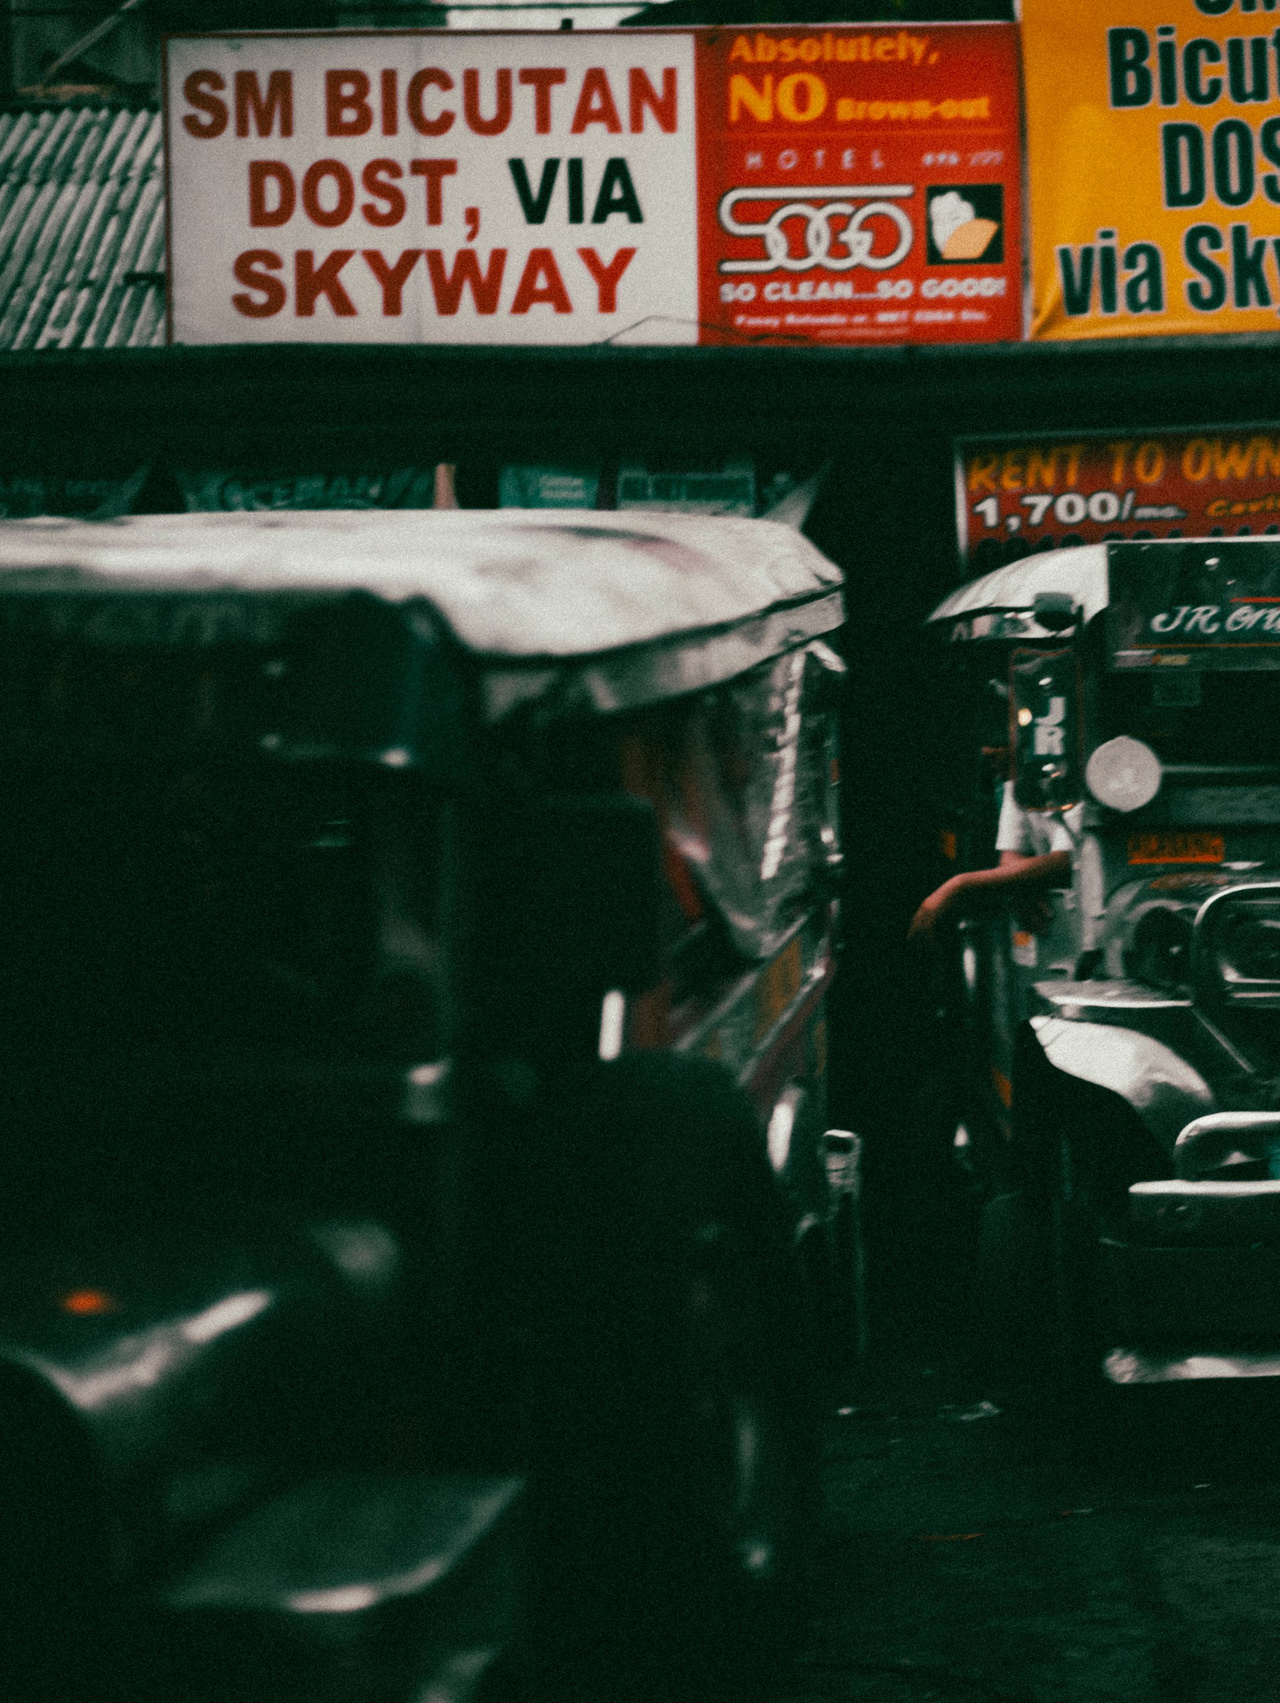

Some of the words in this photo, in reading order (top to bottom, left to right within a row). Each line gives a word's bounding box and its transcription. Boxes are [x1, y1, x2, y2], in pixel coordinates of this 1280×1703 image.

[182, 69, 294, 139] SM
[326, 67, 679, 137] BICUTAN
[730, 72, 827, 122] NO
[745, 149, 885, 170] HOTEL
[248, 158, 480, 242] DOST,
[508, 157, 645, 224] VIA
[719, 184, 914, 273] SOGO
[231, 247, 638, 318] SKYWAY
[719, 281, 756, 303] SO
[1056, 229, 1165, 316] via
[968, 444, 1088, 492] RENT
[1104, 440, 1166, 485] TO
